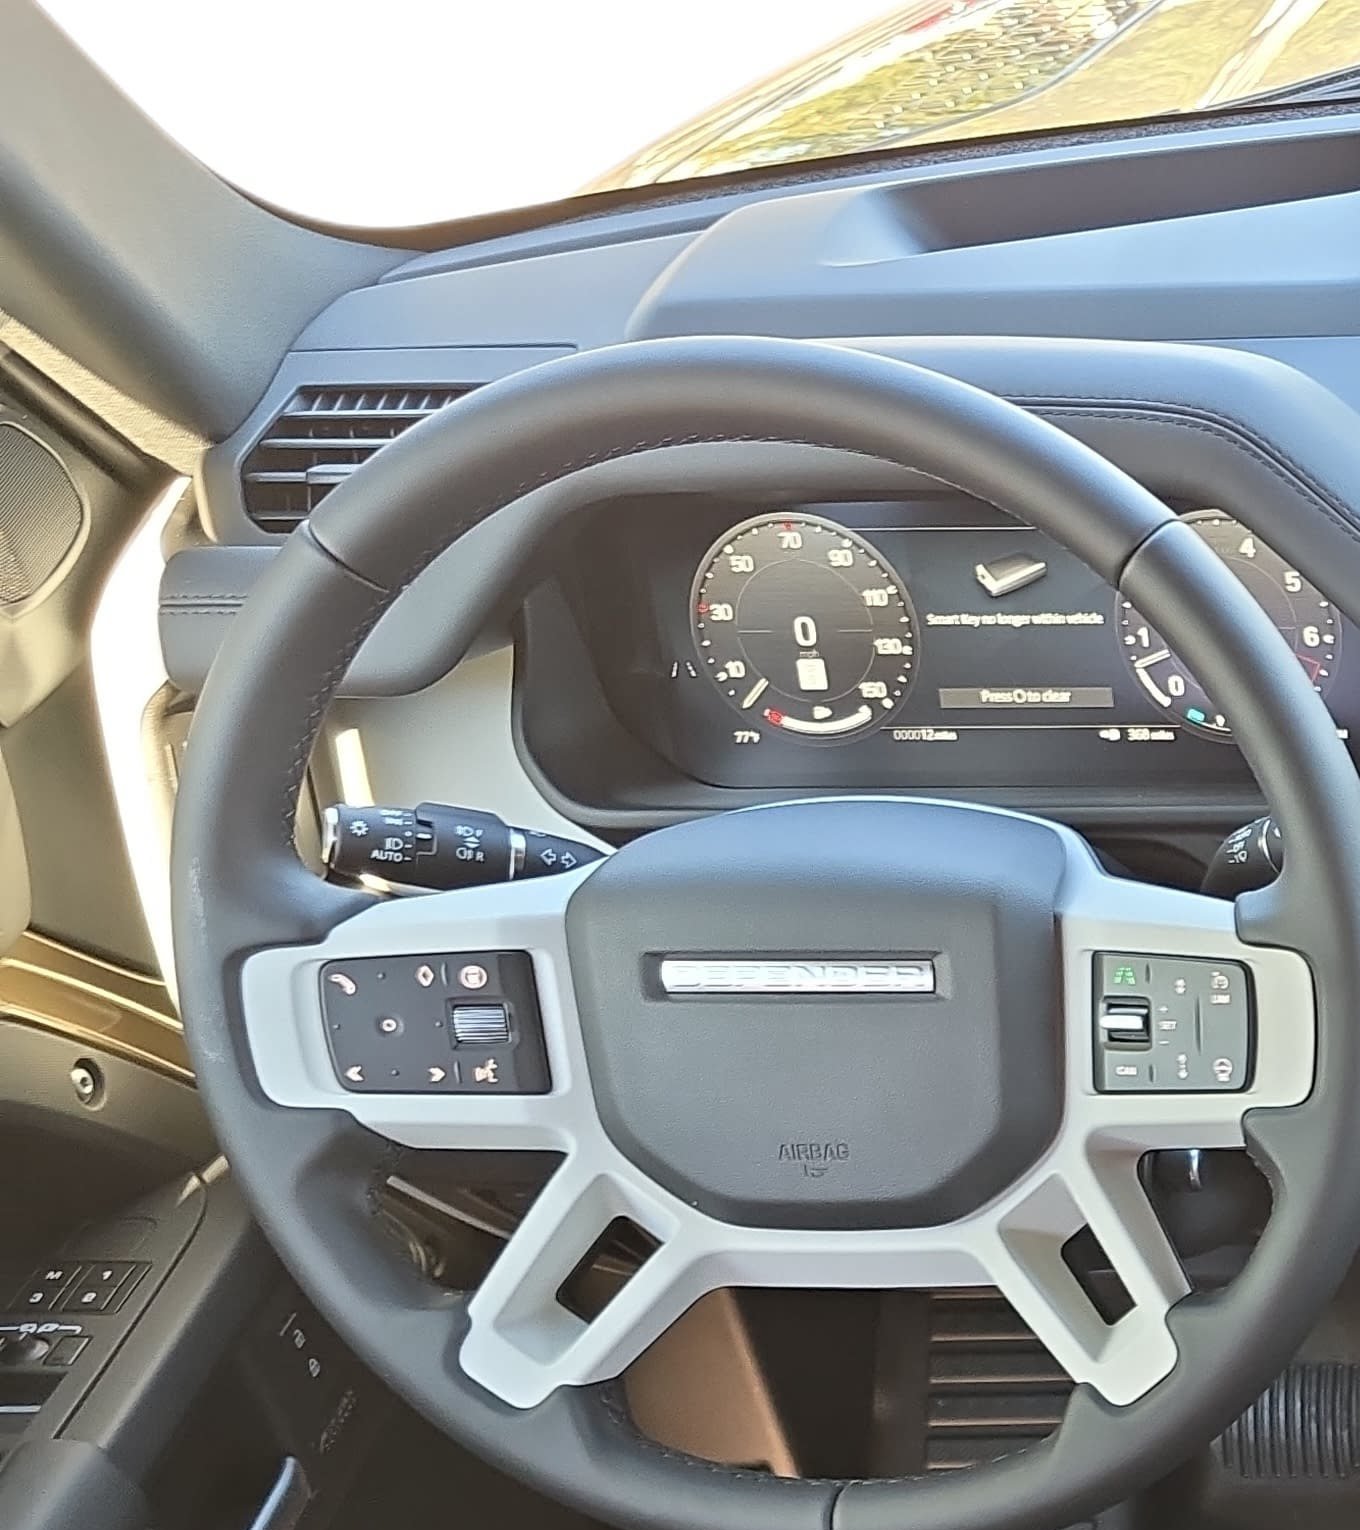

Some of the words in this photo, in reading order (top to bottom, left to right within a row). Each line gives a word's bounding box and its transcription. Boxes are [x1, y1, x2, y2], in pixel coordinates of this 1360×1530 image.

[777, 532, 802, 549] 70
[1238, 537, 1256, 558] 4
[728, 555, 754, 573] 50
[827, 549, 854, 567] 90
[1283, 571, 1302, 592] 5
[709, 603, 734, 621] 30
[793, 616, 817, 646] 0
[1136, 627, 1150, 648] 1
[1302, 626, 1320, 647] 6
[725, 660, 746, 678] 10
[1167, 674, 1185, 697] 0
[980, 689, 1013, 703] Press
[1042, 689, 1071, 703] clear
[370, 848, 403, 863] AUTO
[778, 1142, 850, 1162] AIRBAG
